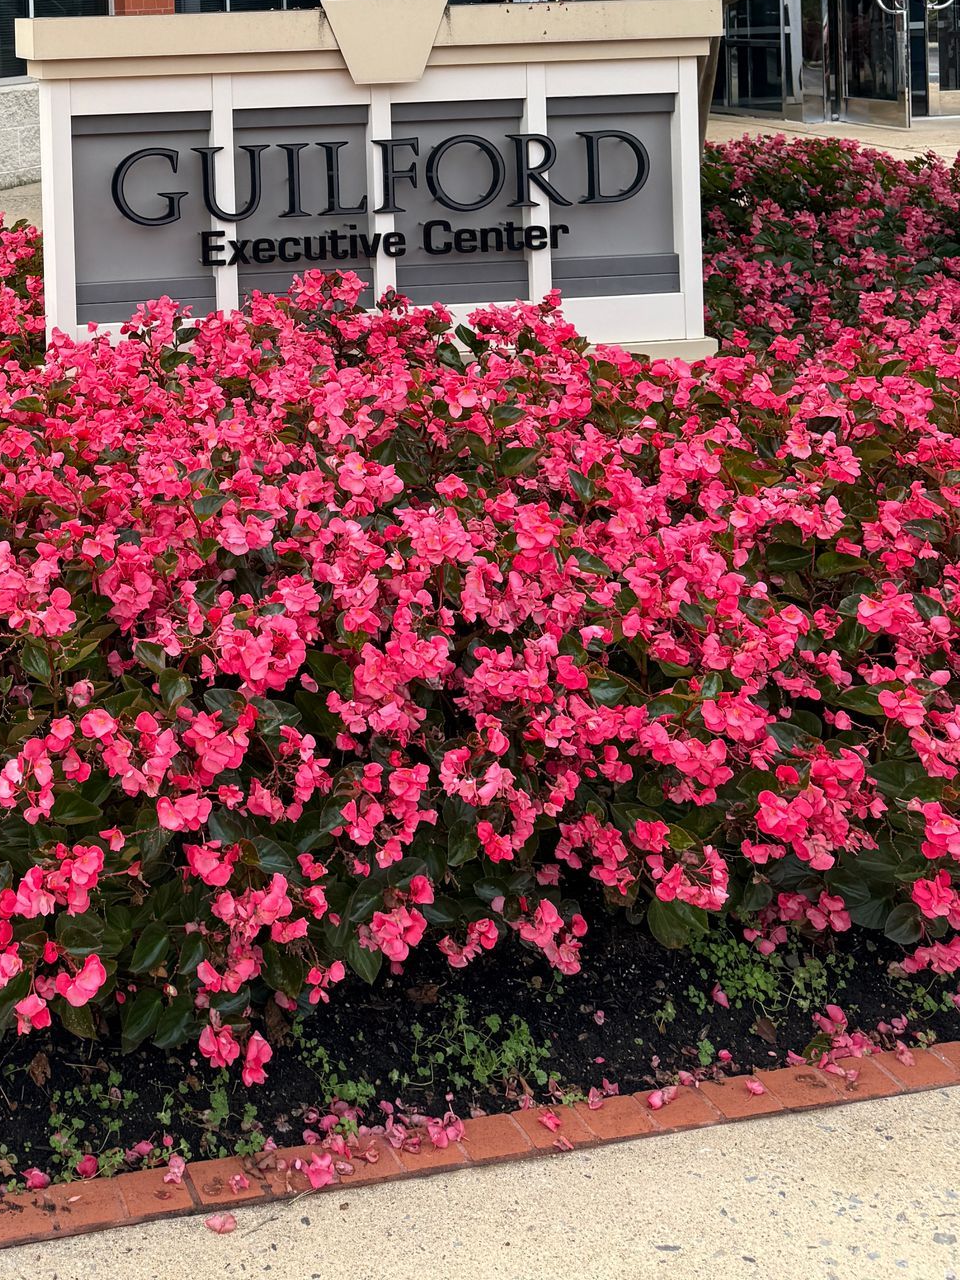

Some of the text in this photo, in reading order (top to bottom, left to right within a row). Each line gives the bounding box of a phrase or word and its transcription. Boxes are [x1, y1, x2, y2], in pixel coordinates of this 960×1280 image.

[111, 129, 650, 226] GUILFORD
[201, 219, 570, 267] Executive Center
